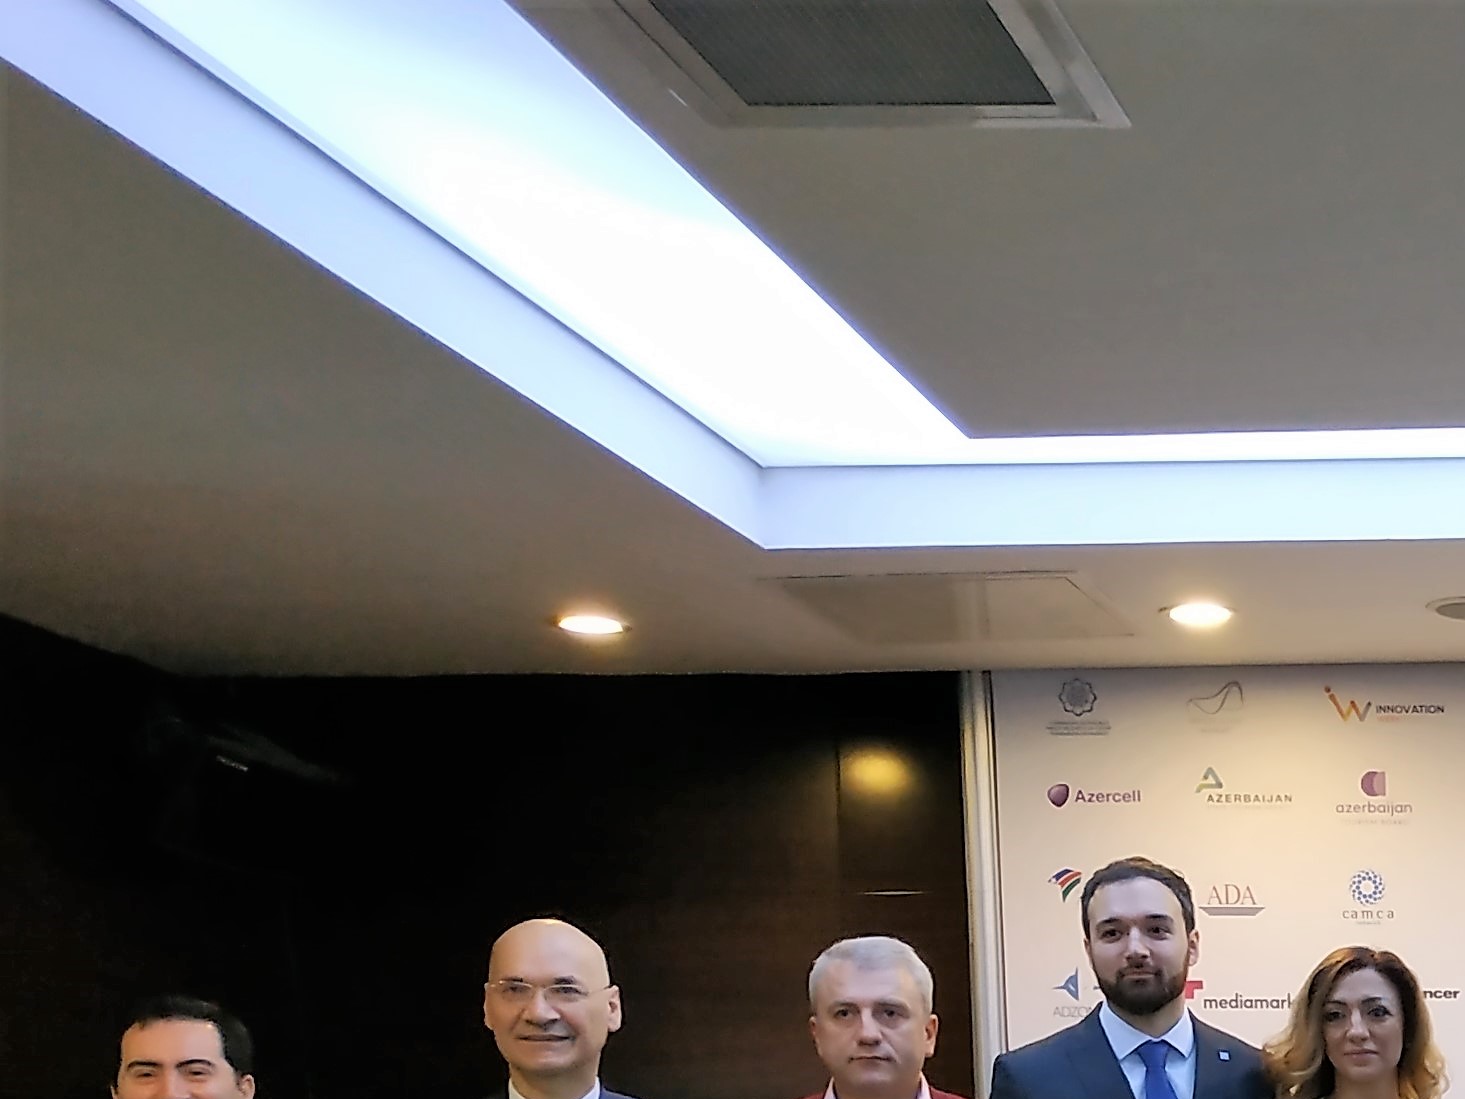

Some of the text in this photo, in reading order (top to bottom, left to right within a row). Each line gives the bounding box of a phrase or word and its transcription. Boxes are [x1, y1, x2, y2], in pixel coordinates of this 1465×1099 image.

[1375, 704, 1445, 714] INNOVATION
[1074, 788, 1142, 803] Azercell
[1206, 793, 1293, 804] AZERBAIJAN
[1335, 801, 1413, 817] azerbaijan
[1207, 883, 1258, 906] ADA
[1341, 908, 1395, 920] camca
